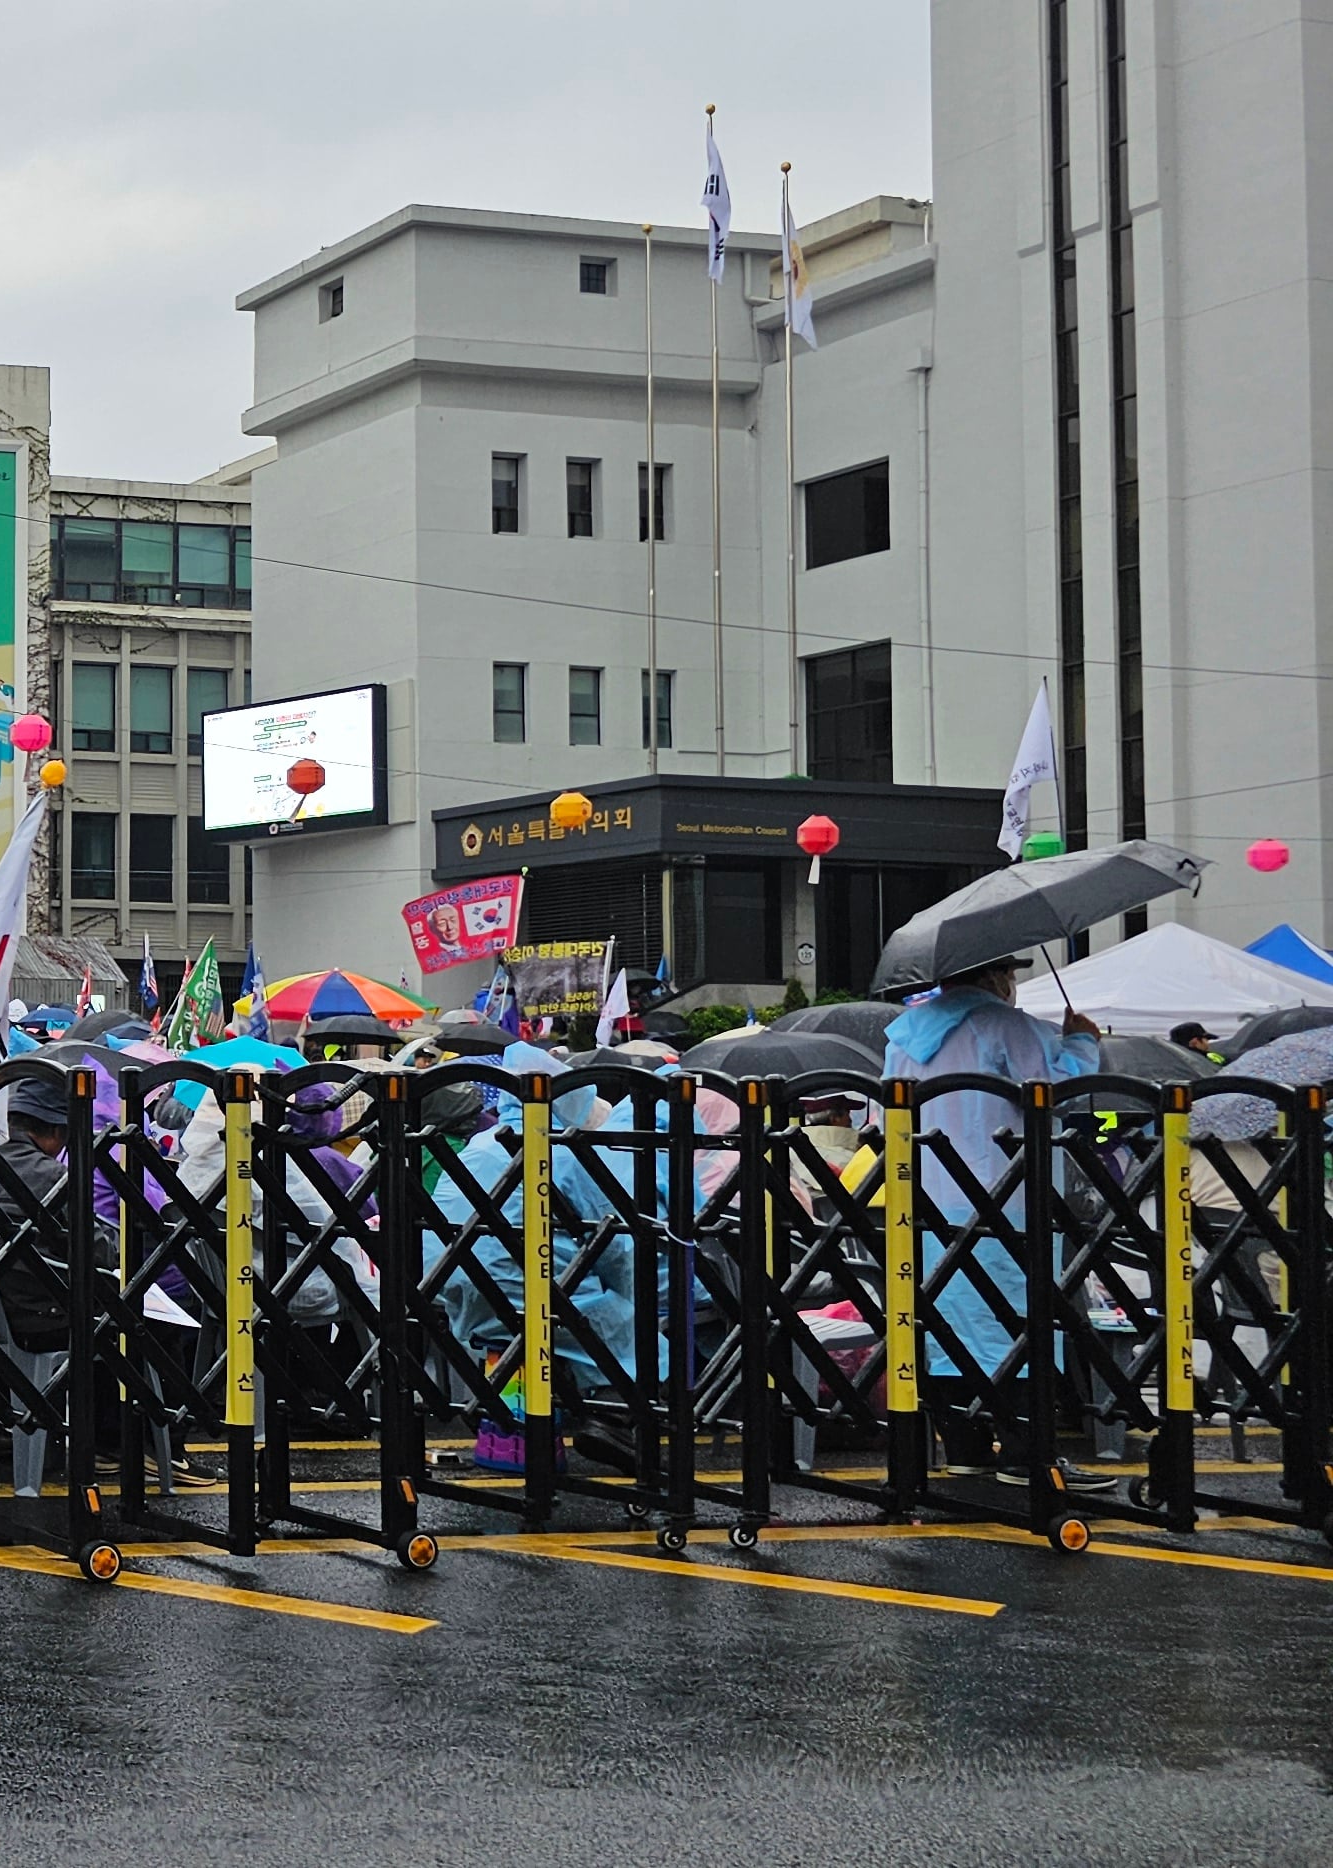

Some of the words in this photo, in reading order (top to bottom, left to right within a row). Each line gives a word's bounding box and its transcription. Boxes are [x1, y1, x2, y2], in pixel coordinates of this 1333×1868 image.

[676, 823, 700, 834] Seoul
[702, 823, 754, 836] Metropolitan
[756, 826, 788, 836] Council
[236, 1159, 253, 1393] 질서유지선
[538, 1159, 549, 1280] POLICE
[894, 1161, 913, 1382] 질서유지선
[1179, 1166, 1192, 1282] POLICE
[540, 1302, 549, 1383] LINE
[1182, 1304, 1194, 1380] LINE
